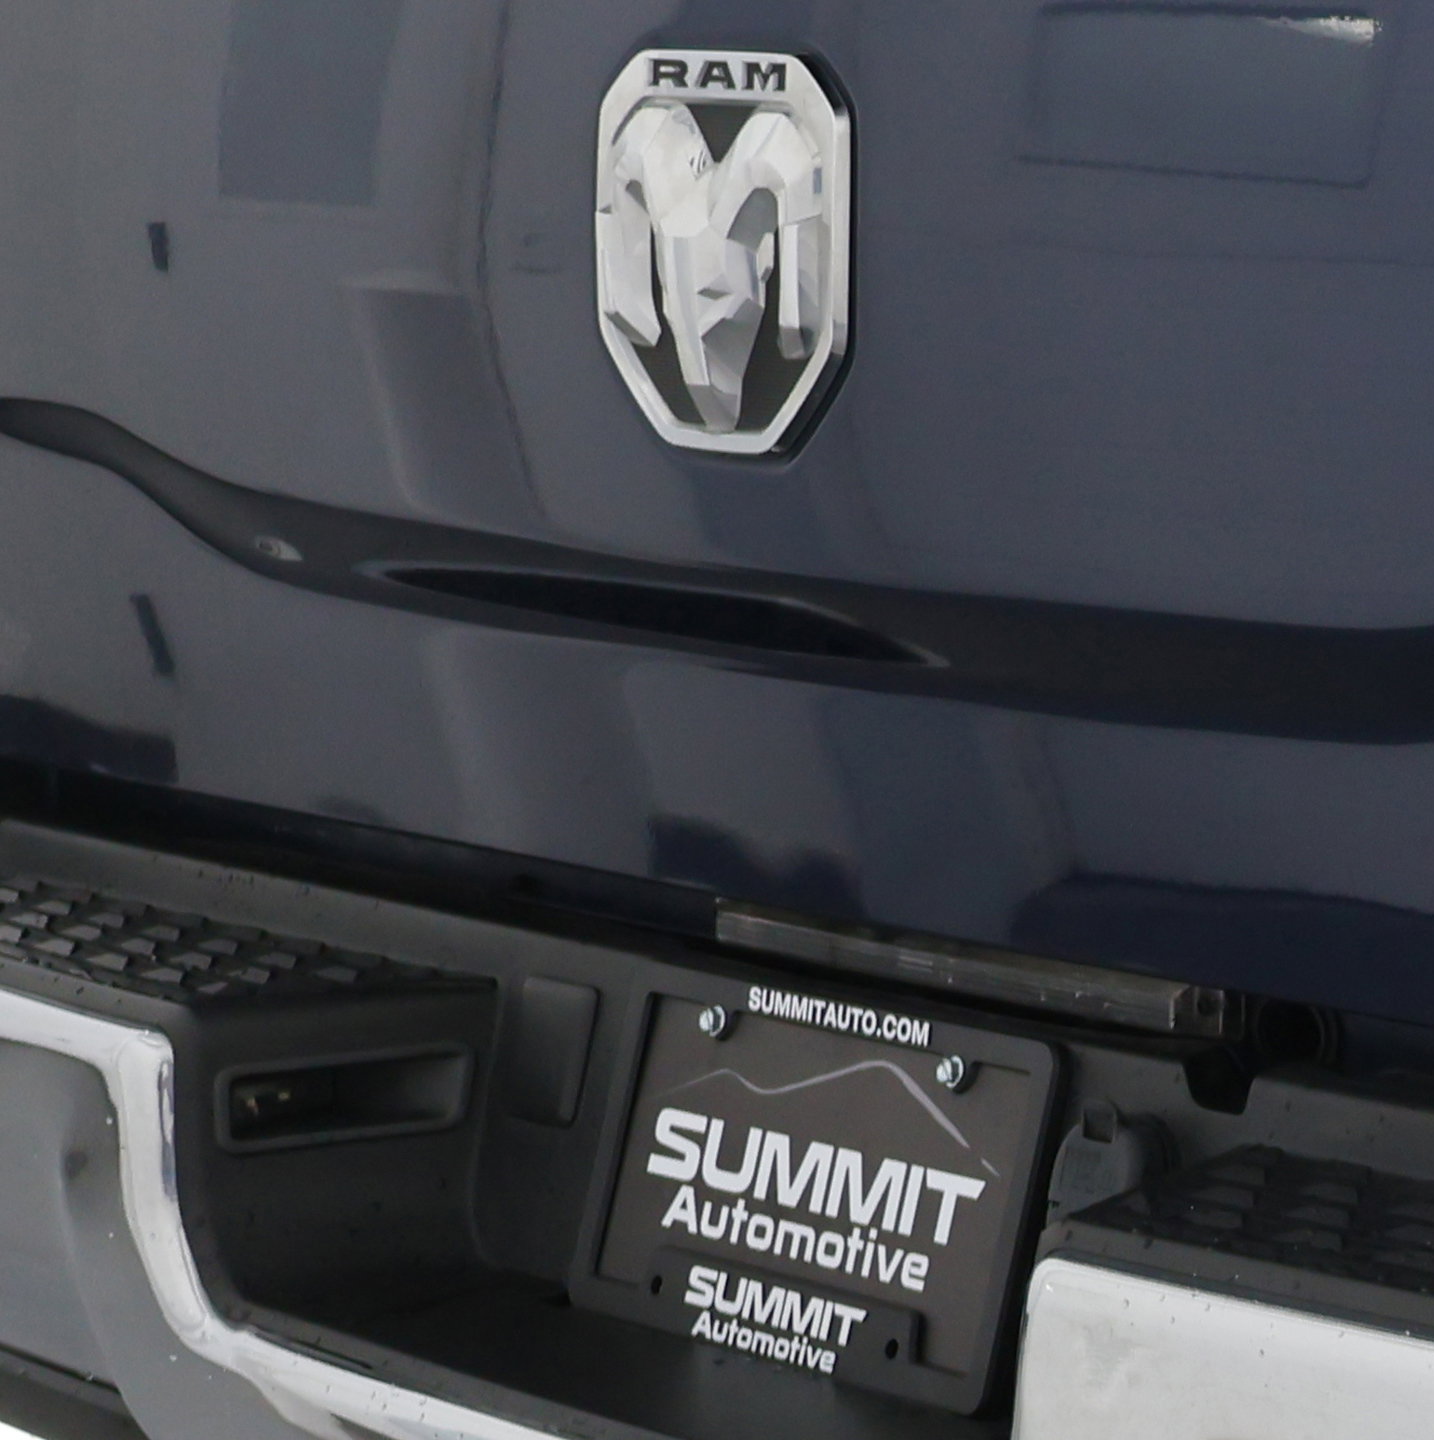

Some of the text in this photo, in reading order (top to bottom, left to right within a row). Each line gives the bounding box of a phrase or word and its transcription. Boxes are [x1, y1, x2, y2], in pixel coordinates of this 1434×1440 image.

[648, 58, 788, 93] RAM
[748, 985, 930, 1048] SUMMITAUTO.COM
[646, 1107, 986, 1247] SUMMIT
[661, 1184, 930, 1292] Automotive
[684, 1264, 867, 1347] SUMMIT
[691, 1309, 837, 1375] Automotive
